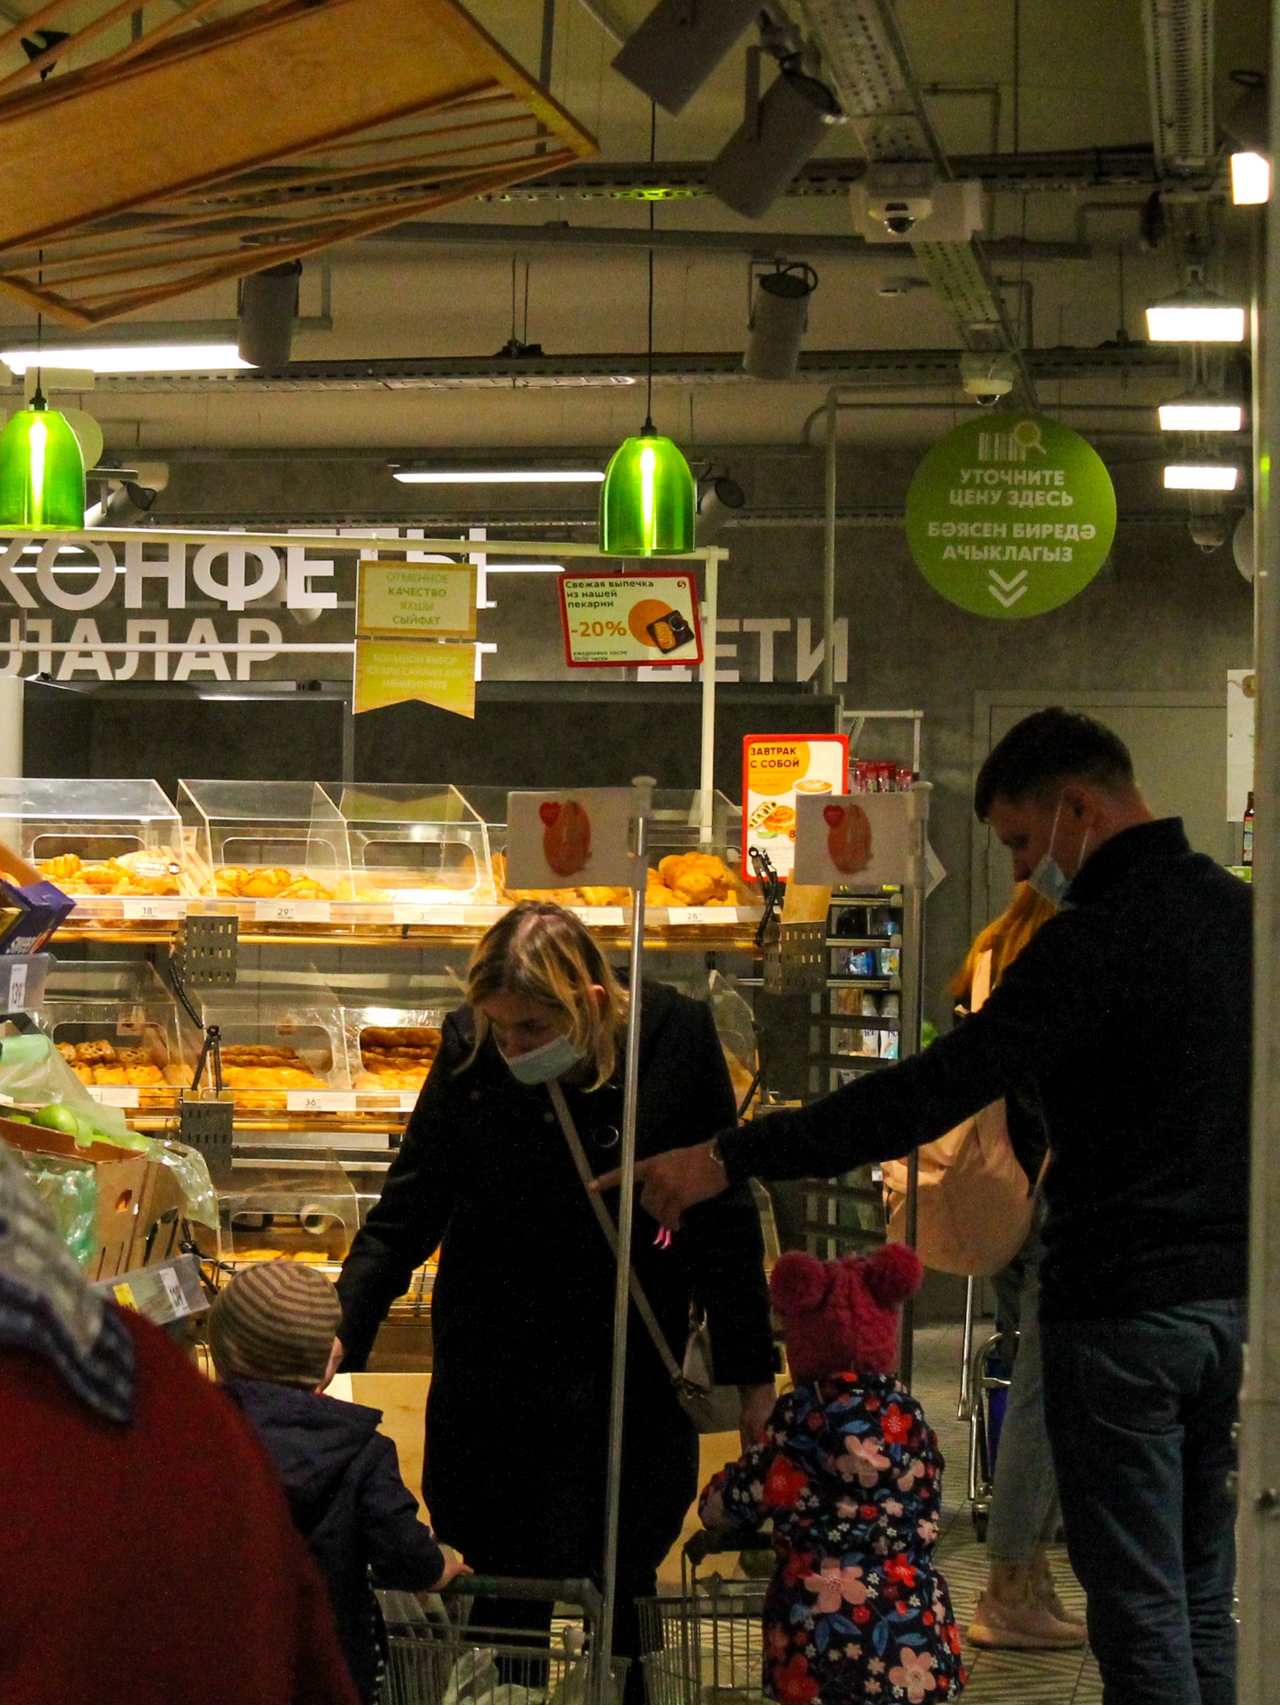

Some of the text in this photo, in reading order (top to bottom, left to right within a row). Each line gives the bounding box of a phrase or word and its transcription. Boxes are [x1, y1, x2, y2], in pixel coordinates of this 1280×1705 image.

[960, 469, 1065, 486] УТОЧНИТЕ
[949, 490, 1074, 509] ЦЕНУ ЗДЕСЬ
[928, 522, 1096, 541] БӘЯСЕН БИРЕДӘ
[942, 545, 1073, 562] АЧЫКЛАГЫЗ
[386, 573, 449, 584] ОТМЕННОЕ
[565, 581, 606, 589] Свежая
[388, 587, 447, 598] КАЧЕСТВО
[582, 589, 617, 598] нашей
[568, 600, 614, 609] пекарни
[392, 613, 441, 625] СЫЙФАТ
[571, 620, 627, 638] -20%
[637, 618, 849, 682] ЕТИ
[750, 747, 796, 756] ЗАВТРАК
[760, 757, 799, 768] СОБОЙ
